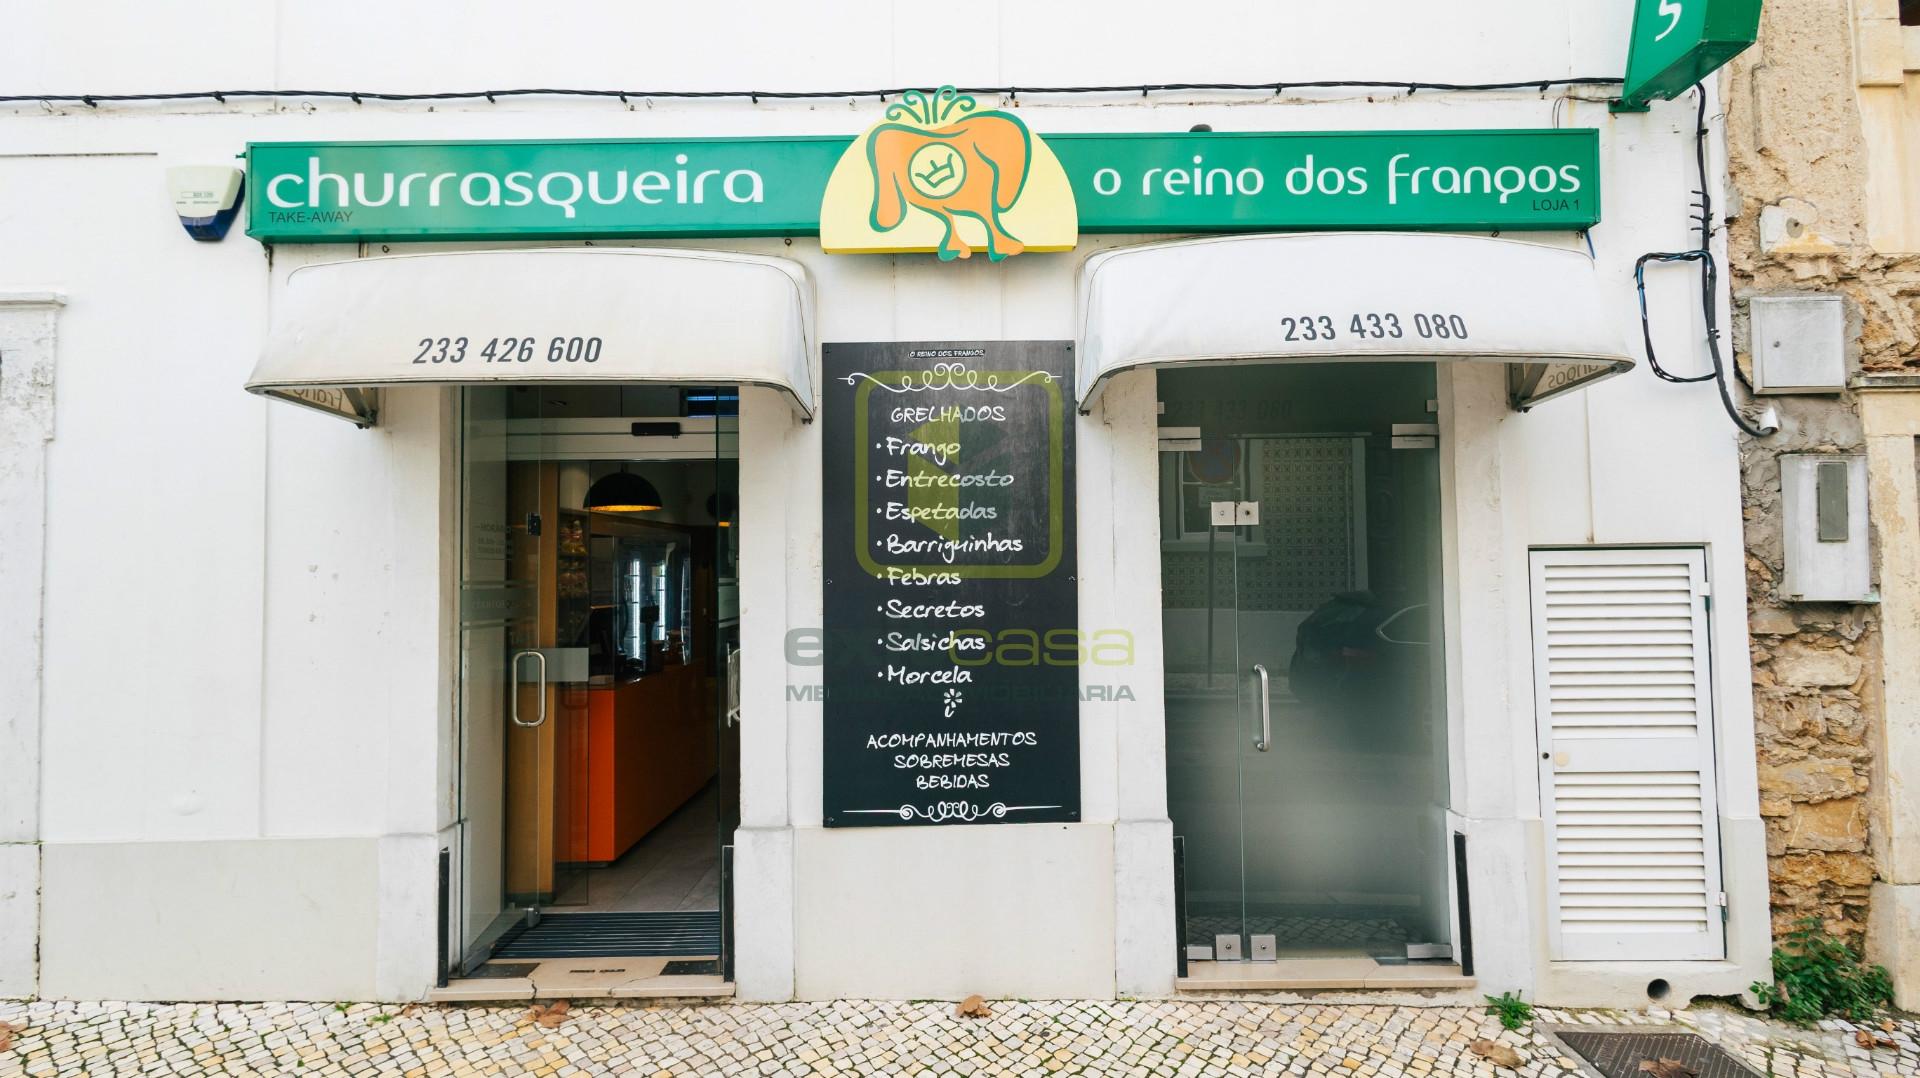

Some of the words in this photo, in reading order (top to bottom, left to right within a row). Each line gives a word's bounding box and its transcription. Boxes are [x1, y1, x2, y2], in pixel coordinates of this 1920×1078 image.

[267, 153, 764, 219] churrasqueira
[1093, 168, 1122, 196] o
[1142, 155, 1264, 196] reino
[1285, 154, 1368, 195] dos
[1388, 153, 1580, 205] frangos
[1532, 199, 1570, 211] LOJA
[1573, 199, 1580, 211] 1
[268, 210, 354, 224] TAKE-AWAY
[1281, 315, 1336, 342] 233
[1349, 313, 1403, 339] 433
[1413, 313, 1468, 340] 080
[412, 337, 469, 364] 233
[480, 337, 535, 363] 426
[547, 337, 603, 363] 600
[891, 405, 1007, 423] GRELHADOS
[886, 436, 962, 466] Frango
[886, 469, 1014, 488] Entrecosto
[886, 501, 998, 523] Espetadas
[887, 532, 1023, 563] Barriguinhas
[887, 566, 962, 586] Febras
[885, 599, 985, 619] Secretos
[885, 631, 986, 651] Salsichas
[887, 665, 973, 685] Morcela
[866, 731, 1038, 749] ACOMPANHAMENTOS
[893, 753, 1011, 769] SOBREMESAS
[916, 774, 990, 789] BEBIDAS
